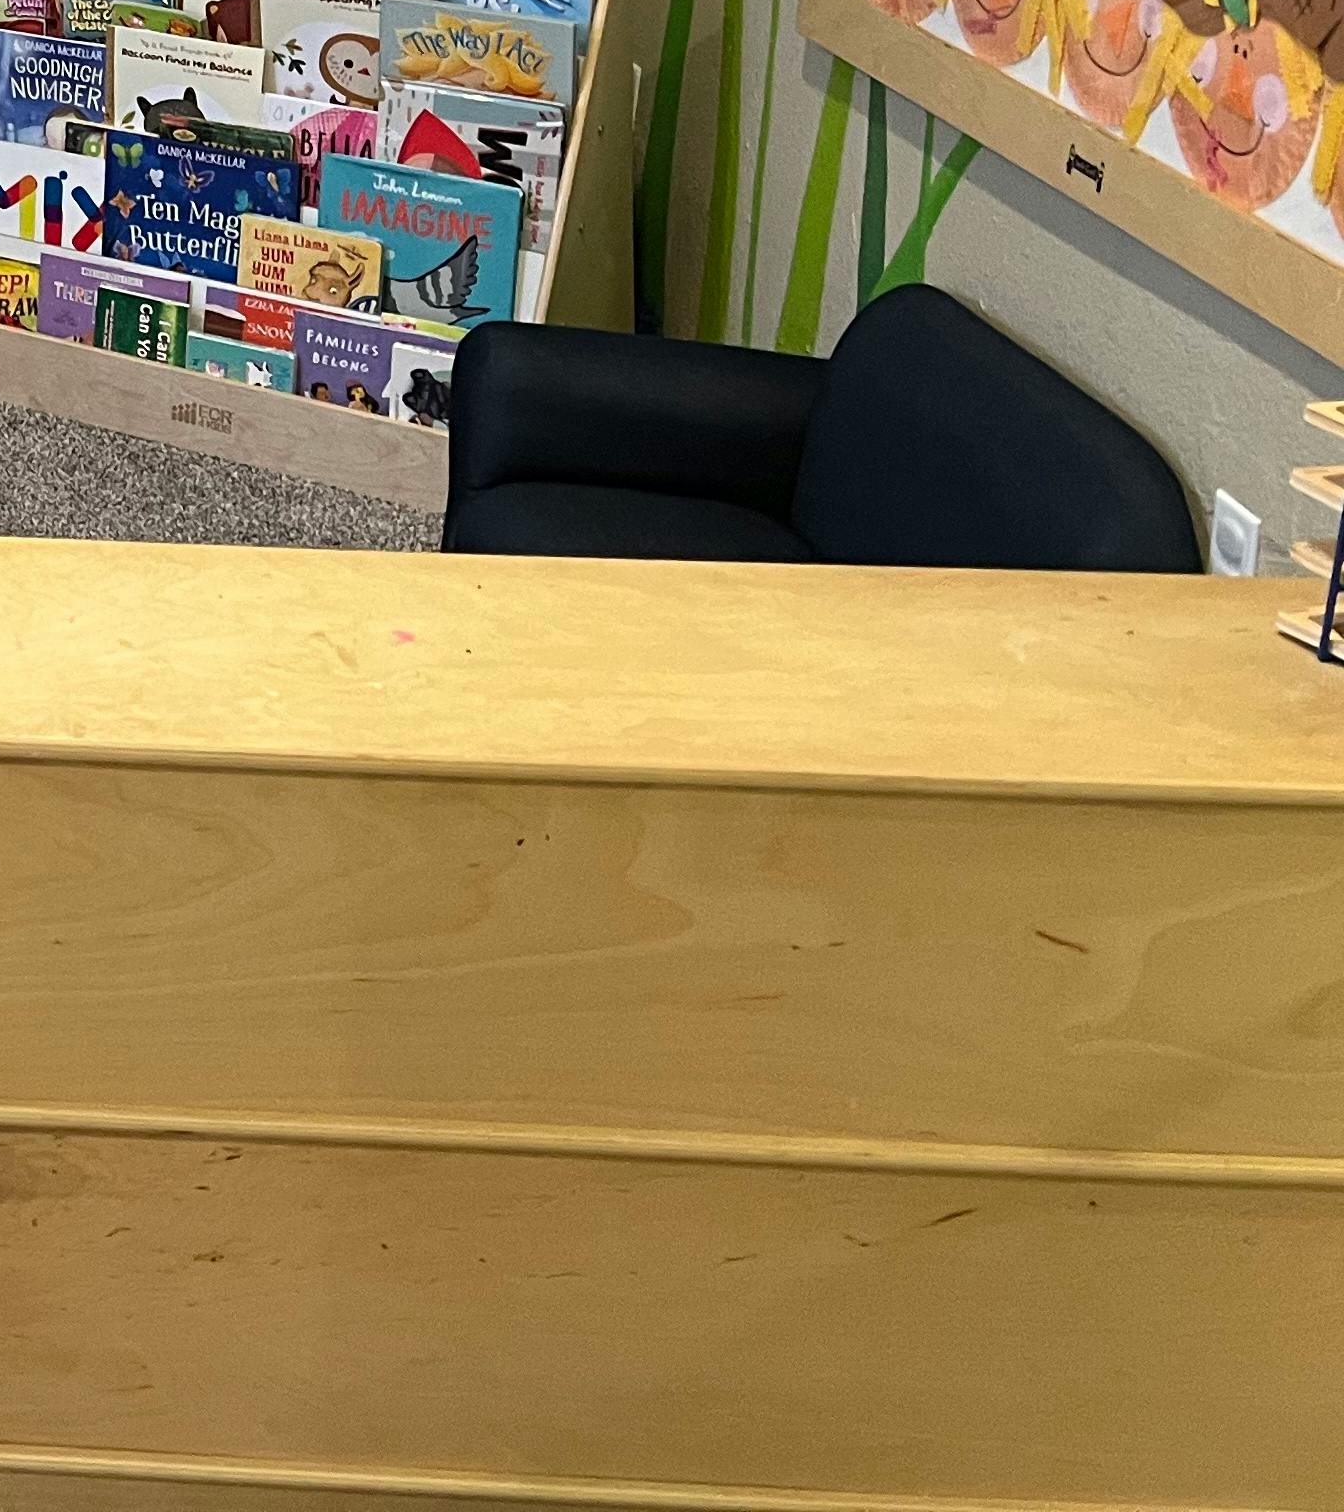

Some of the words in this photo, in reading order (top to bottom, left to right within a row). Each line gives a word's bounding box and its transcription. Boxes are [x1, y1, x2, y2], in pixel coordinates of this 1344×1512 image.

[67, 11, 79, 21] of
[82, 10, 101, 21] the
[24, 40, 56, 54] DANICA
[121, 47, 165, 62] Raccoon
[165, 54, 191, 66] Finds
[210, 61, 253, 76] Balance
[403, 31, 450, 59] The
[448, 26, 491, 59] Way
[506, 38, 545, 74] Act
[15, 56, 103, 86] GOODNIGH
[10, 77, 105, 112] NUMBER
[157, 143, 192, 161] DANICA
[195, 152, 246, 170] McKELLAR
[373, 173, 408, 196] John
[411, 180, 463, 206] Lennon
[136, 194, 180, 223] Ten
[188, 200, 241, 239] Mag
[342, 189, 493, 249] IMAGINE
[130, 225, 239, 267] Butterfli
[254, 228, 289, 245] Llama
[294, 235, 329, 252] Llama
[139, 303, 153, 333] Can
[244, 298, 274, 313] EZRA
[137, 340, 151, 358] Yo
[157, 331, 171, 361] Can
[306, 329, 379, 358] FAMILIES
[312, 351, 370, 374] BELONG
